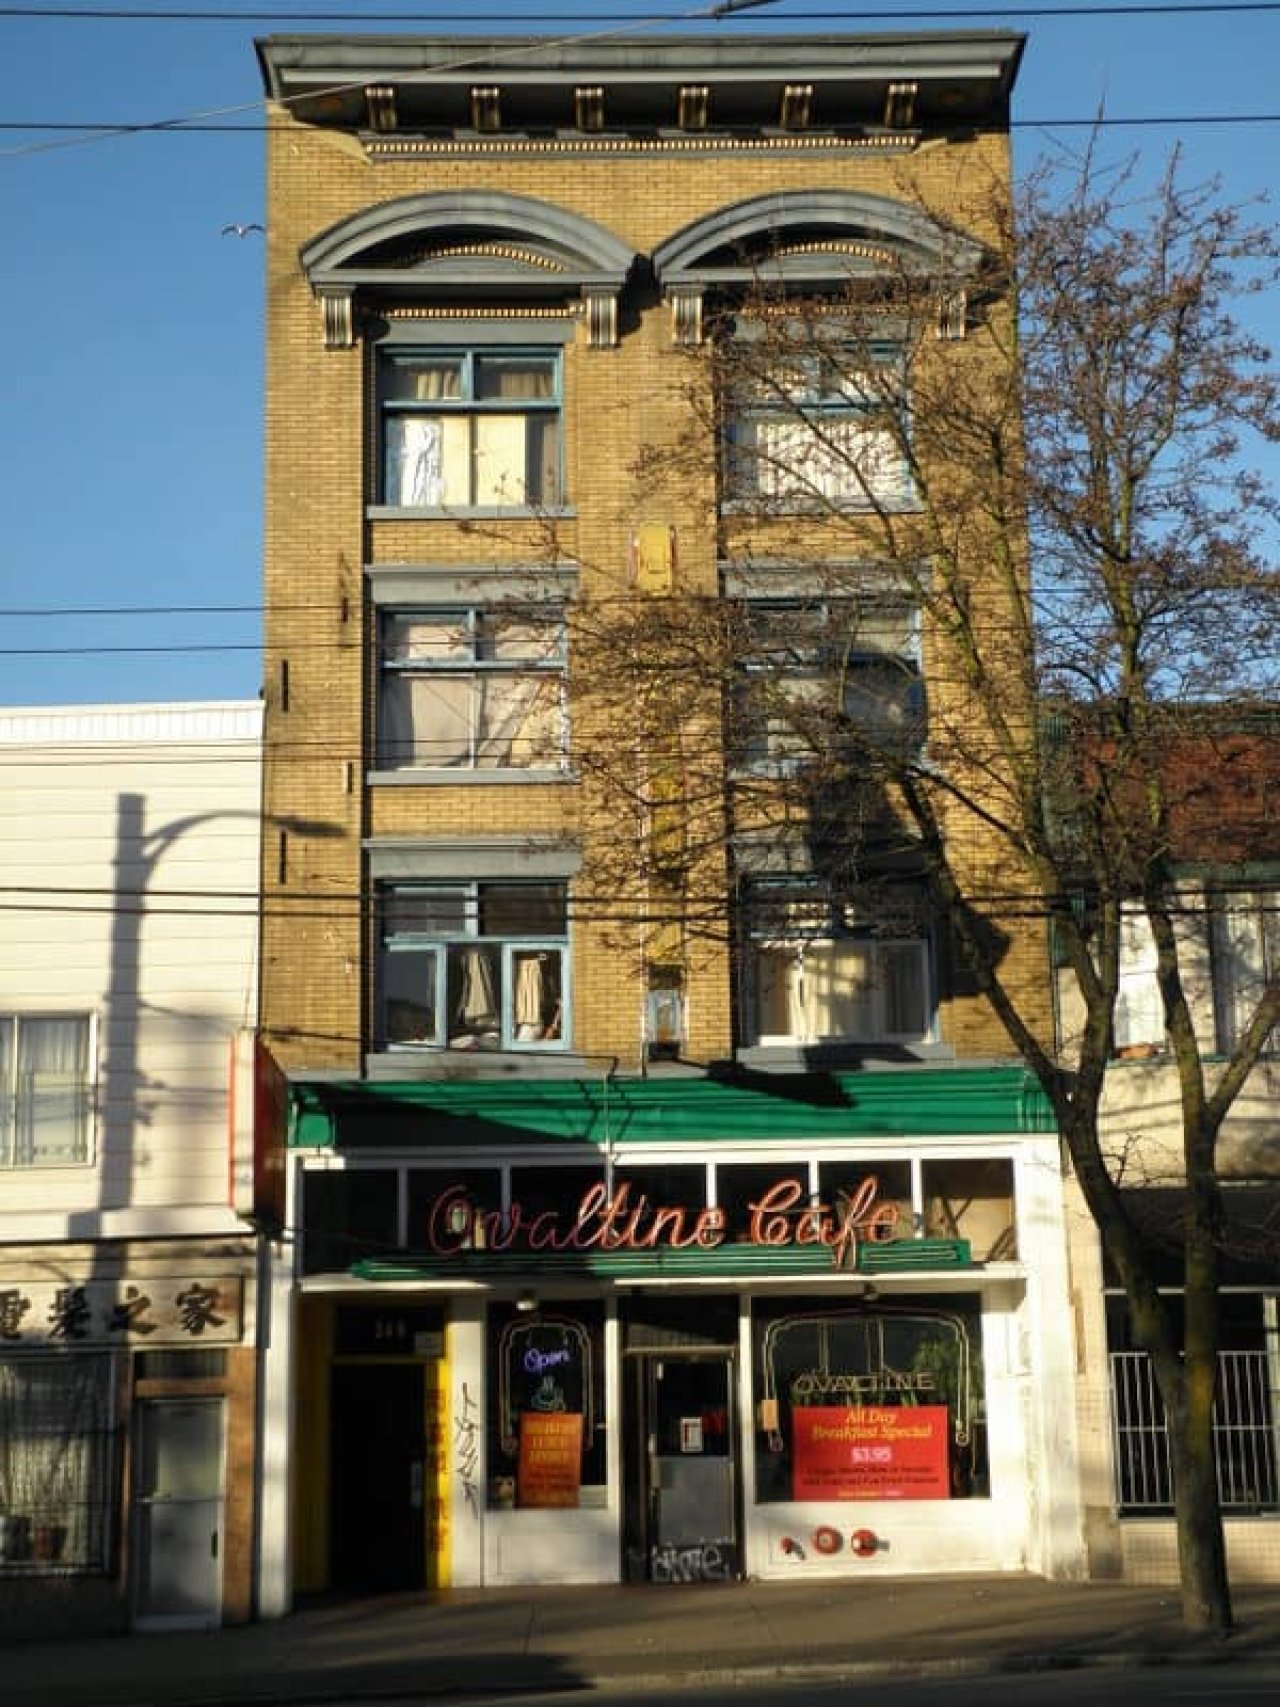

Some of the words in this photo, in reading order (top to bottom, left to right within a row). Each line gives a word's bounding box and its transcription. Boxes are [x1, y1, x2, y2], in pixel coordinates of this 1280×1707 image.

[428, 1179, 727, 1257] Ovaltine
[746, 1174, 901, 1270] Cafe
[524, 1348, 571, 1375] Open
[793, 1372, 937, 1394] OVALTINE
[869, 1409, 898, 1428] Day
